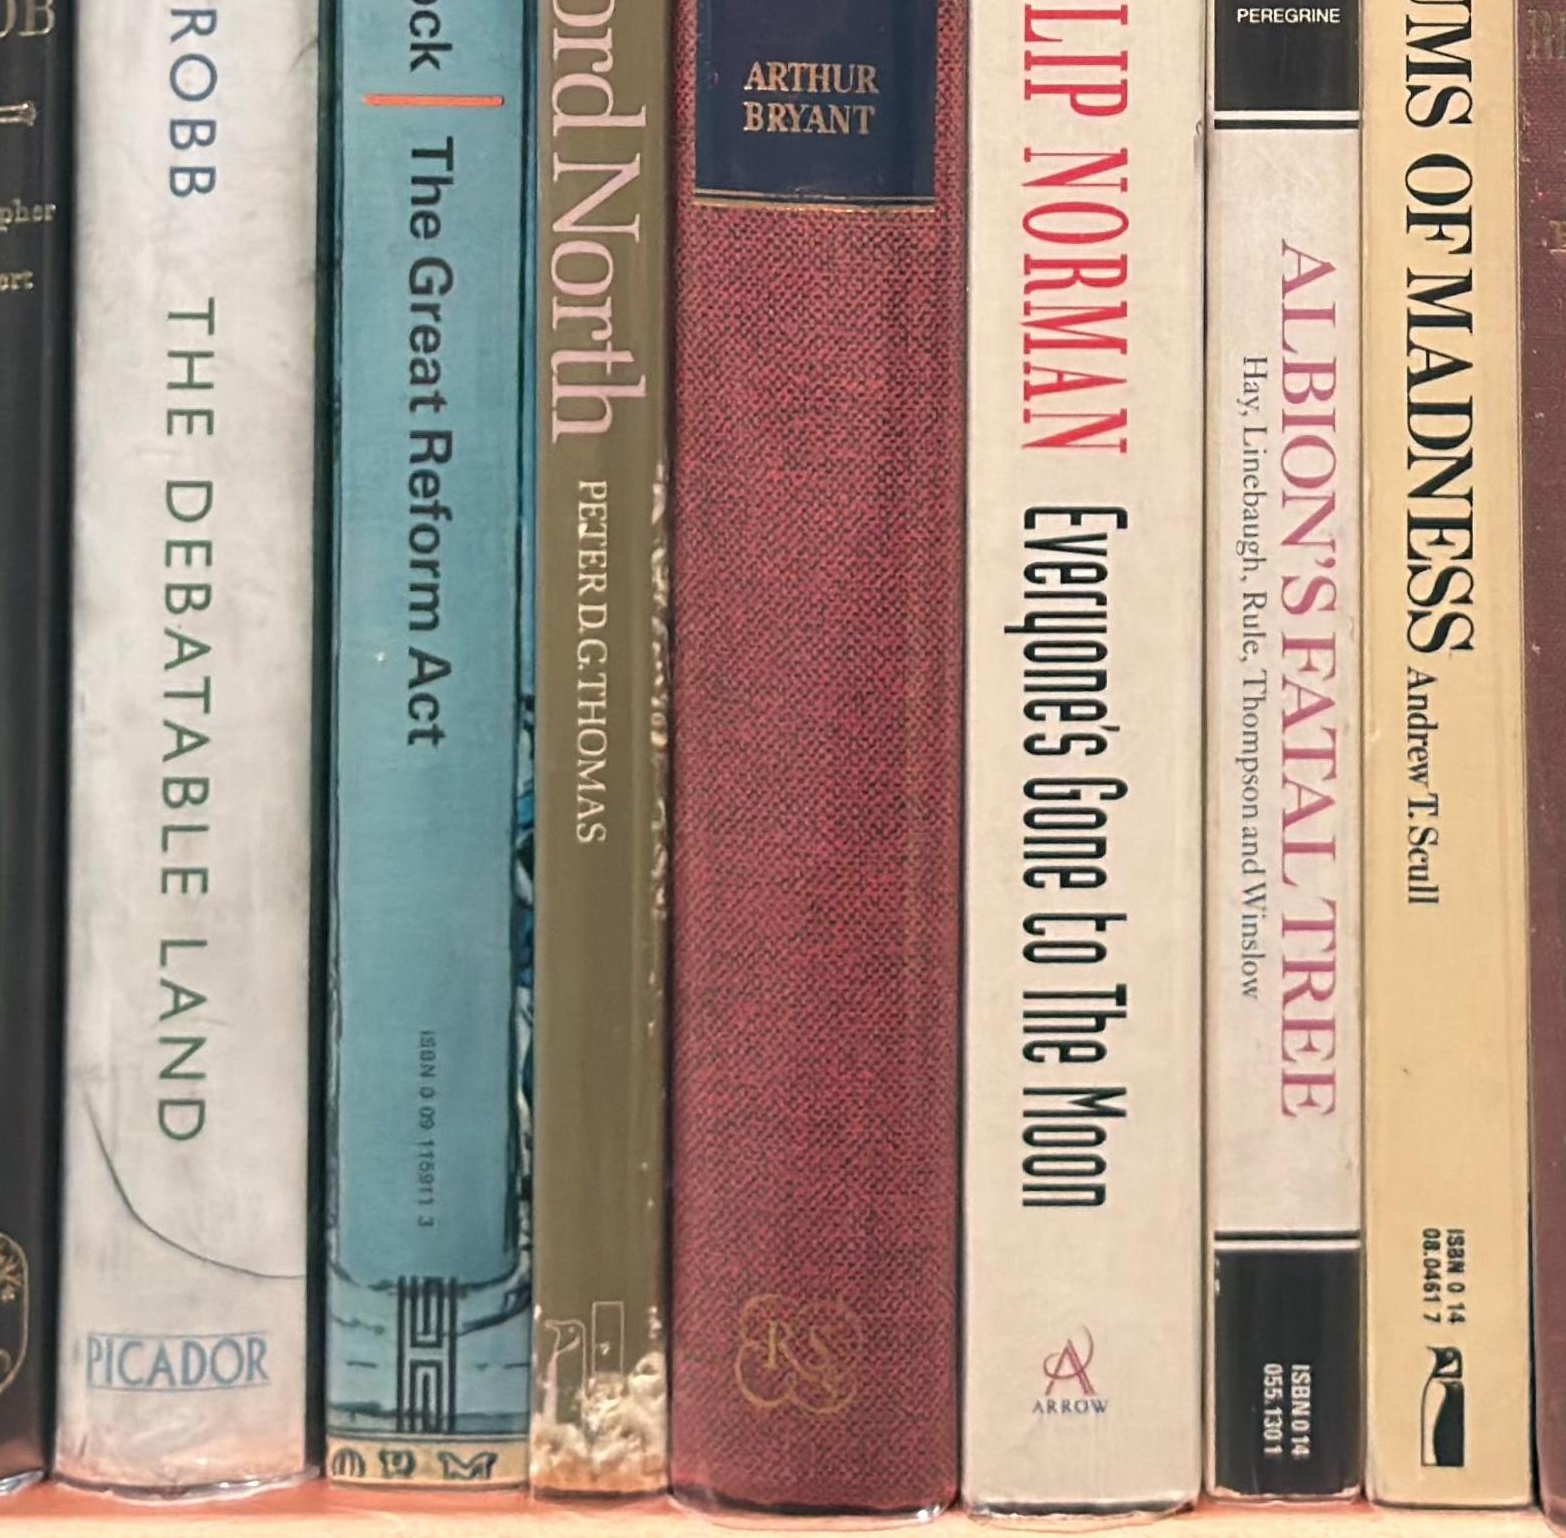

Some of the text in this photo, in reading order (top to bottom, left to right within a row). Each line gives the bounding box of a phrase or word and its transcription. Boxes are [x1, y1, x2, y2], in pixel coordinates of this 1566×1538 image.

[1236, 7, 1342, 25] PEREGRINE
[168, 8, 218, 200] ROBB
[743, 62, 880, 95] ARTHUR
[743, 103, 875, 134] BRYANT
[408, 136, 455, 241] The
[1404, 152, 1474, 255] OF
[407, 268, 455, 413] Great
[550, 159, 647, 444] North
[1020, 147, 1129, 454] NORMAN
[165, 297, 215, 439] THE
[1406, 267, 1475, 654] MADNESS
[406, 432, 455, 633] Reform
[578, 480, 609, 597] PETER
[1004, 505, 1128, 756] Everyone's
[1235, 356, 1268, 1001] Hay, Linebaugh, Rule, Thompson and Winslow
[1281, 238, 1338, 1119] ALBION'S FATAL TREE
[161, 481, 214, 896] DEBATABLE
[405, 654, 454, 748] Act
[1407, 666, 1439, 786] Andrew
[1022, 777, 1129, 889] Gone
[1407, 793, 1439, 819] T.
[1407, 825, 1440, 905] Scull
[1022, 913, 1128, 964] to
[157, 938, 207, 1144] LAND
[419, 1029, 437, 1078] ISBN
[1022, 983, 1128, 1064] The
[1021, 1086, 1128, 1207] Moon
[1446, 1228, 1466, 1324] ISBN 0 14
[87, 1334, 268, 1386] PICADOR
[1032, 1399, 1109, 1415] ARROW
[1291, 1365, 1312, 1415] ISBN
